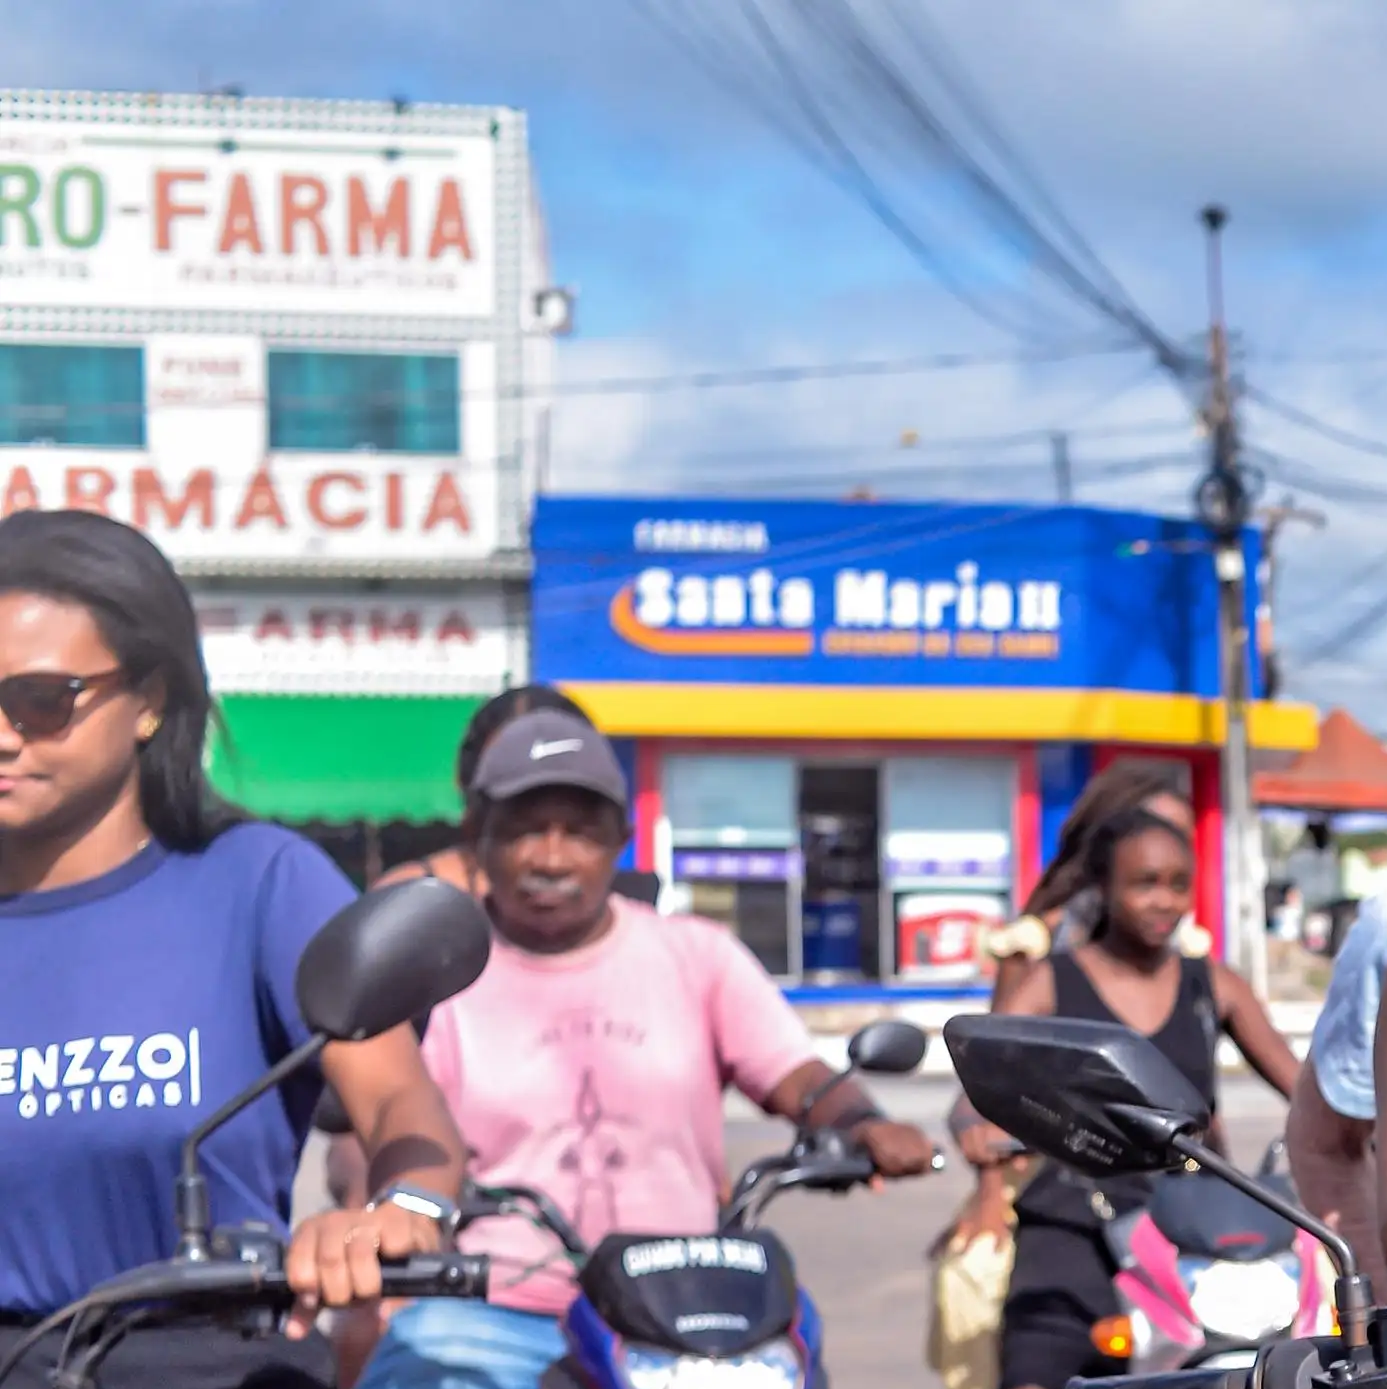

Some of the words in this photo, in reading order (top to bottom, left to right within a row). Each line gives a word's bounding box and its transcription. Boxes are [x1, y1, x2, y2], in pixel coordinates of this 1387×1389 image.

[635, 567, 814, 628] Santa
[834, 560, 1013, 630] Maria
[18, 1080, 183, 1120] OPTICAS
